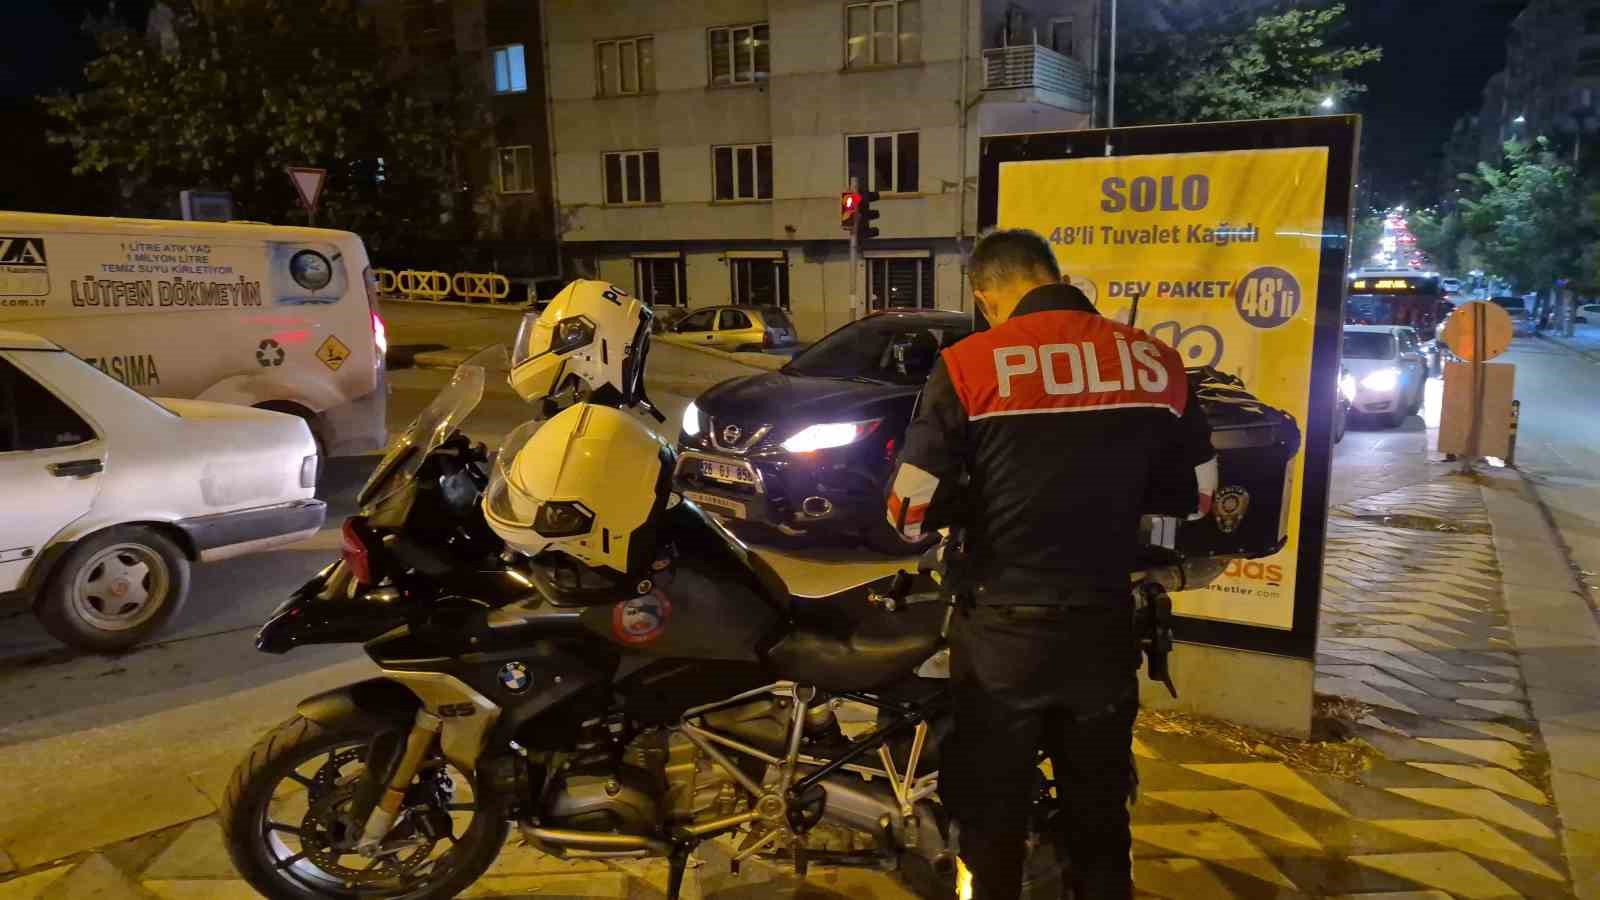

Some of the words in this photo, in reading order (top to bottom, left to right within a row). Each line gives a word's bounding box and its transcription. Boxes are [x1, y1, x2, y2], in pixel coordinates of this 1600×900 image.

[1100, 174, 1210, 213] SOLO
[1050, 225, 1094, 246] 48'li
[1101, 225, 1179, 245] Tuvalet
[1187, 223, 1259, 247] Kağıdı
[0, 239, 47, 263] ZA
[129, 240, 161, 252] LİTRE
[163, 244, 187, 253] ATIK
[135, 253, 176, 263] MİLYON
[178, 253, 209, 264] LİTRE
[138, 264, 169, 273] SUYU
[71, 275, 153, 307] LÜTFEN
[159, 275, 262, 307] DÖKMEYİN
[1108, 281, 1151, 298] DEV
[1157, 281, 1232, 298] PAKET
[1241, 277, 1294, 318] 48'li
[0, 299, 47, 308] com.tr
[992, 332, 1169, 398] POLİS
[1205, 583, 1280, 599] arketler.com
